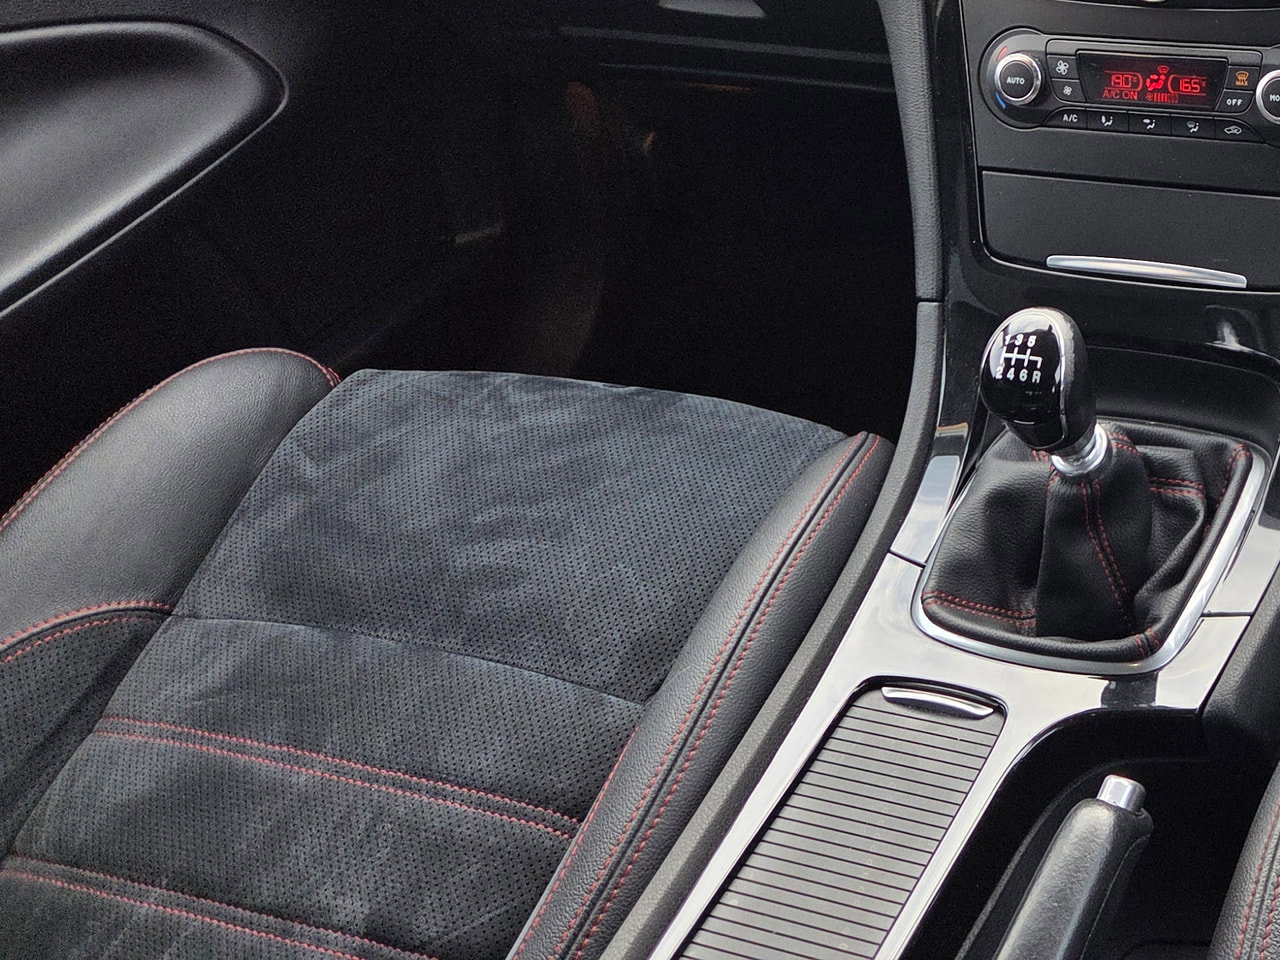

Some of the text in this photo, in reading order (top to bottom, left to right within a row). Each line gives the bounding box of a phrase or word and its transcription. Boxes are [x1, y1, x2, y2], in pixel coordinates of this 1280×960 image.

[1006, 76, 1026, 85] AUTO
[1103, 90, 1138, 100] A/C ON
[1226, 97, 1243, 106] OFF
[1062, 113, 1078, 123] A/C
[1015, 334, 1024, 345] 3
[1027, 335, 1036, 347] 5
[995, 366, 1004, 379] 2
[1006, 367, 1015, 381] 4
[1019, 369, 1028, 382] 6
